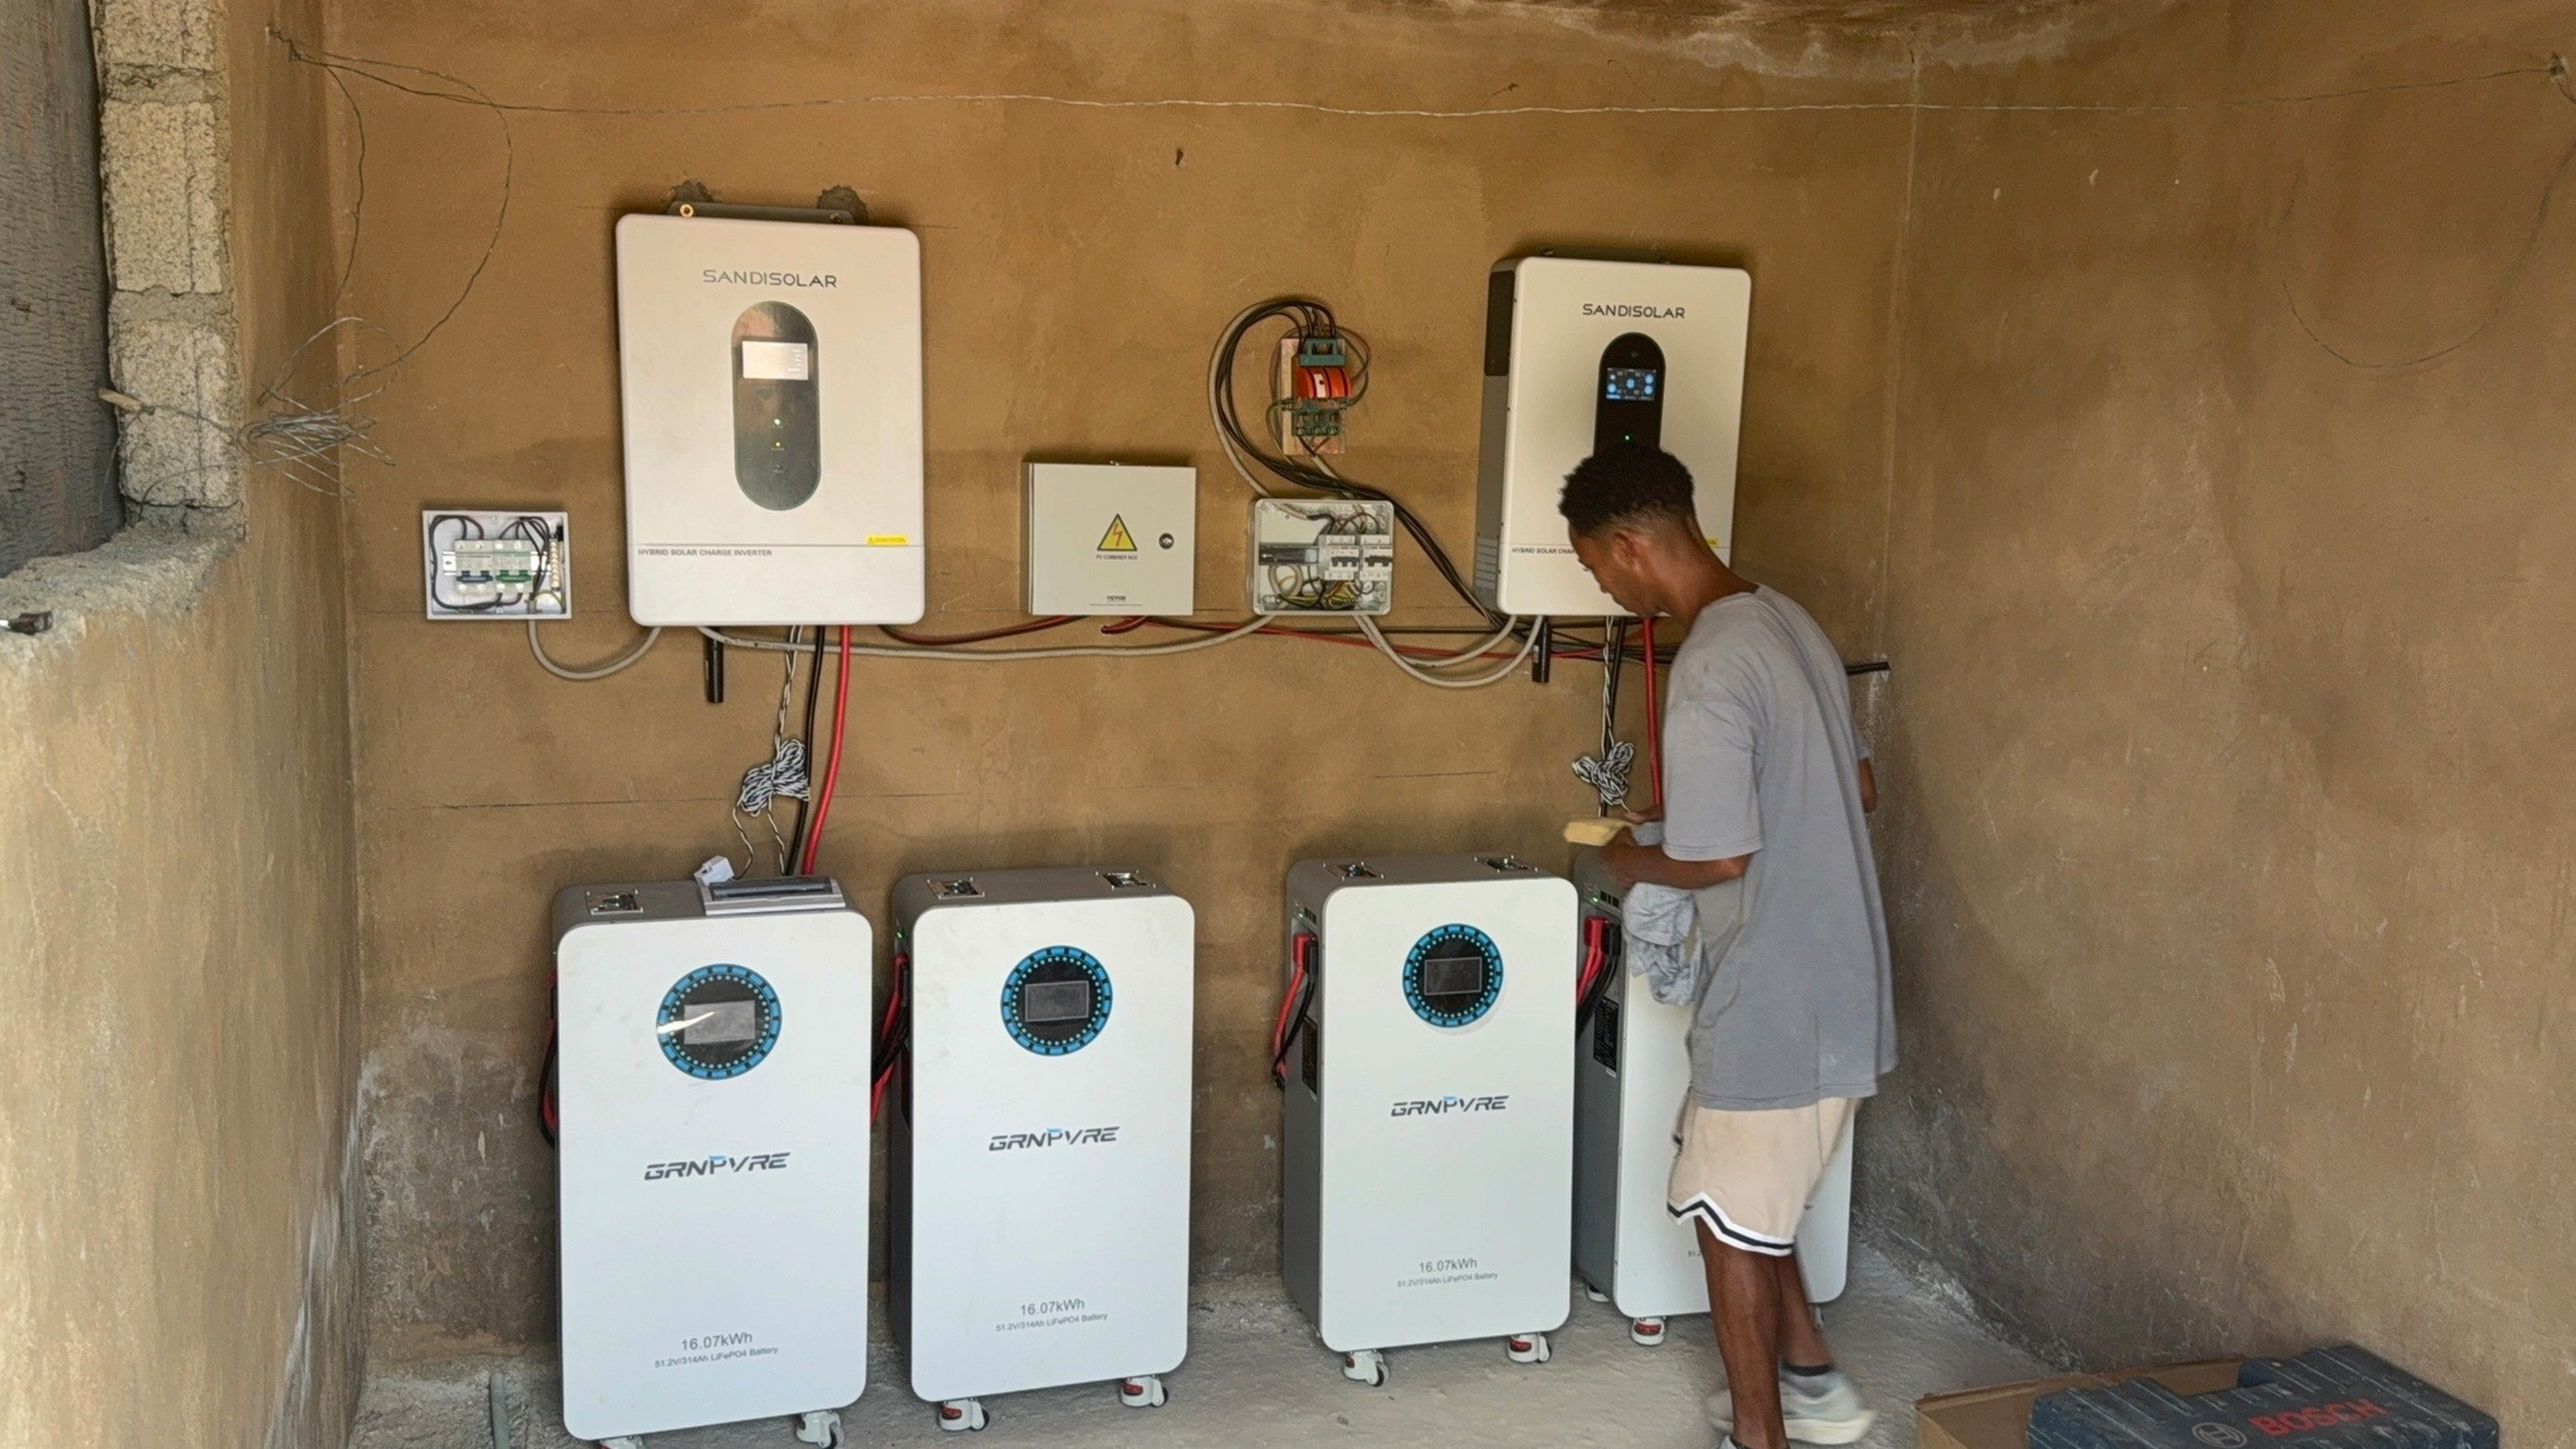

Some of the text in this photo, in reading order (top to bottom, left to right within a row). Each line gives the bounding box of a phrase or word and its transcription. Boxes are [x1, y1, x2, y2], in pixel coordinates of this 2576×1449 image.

[703, 269, 838, 288] SANDISOLAR
[1582, 303, 1686, 319] SANDISOLAR
[1419, 1258, 1478, 1273] 16.07kWh
[1474, 1273, 1498, 1281] Battery
[1021, 1298, 1085, 1316] 16.07kWh
[996, 1320, 1045, 1332] 51.2V/314Ah
[1081, 1313, 1108, 1322] Battery
[682, 1332, 753, 1350] 16.07kWh
[655, 1355, 708, 1368] 51.2V/314Ah
[749, 1346, 779, 1356] Battery
[2249, 1399, 2387, 1436] BOSCH
